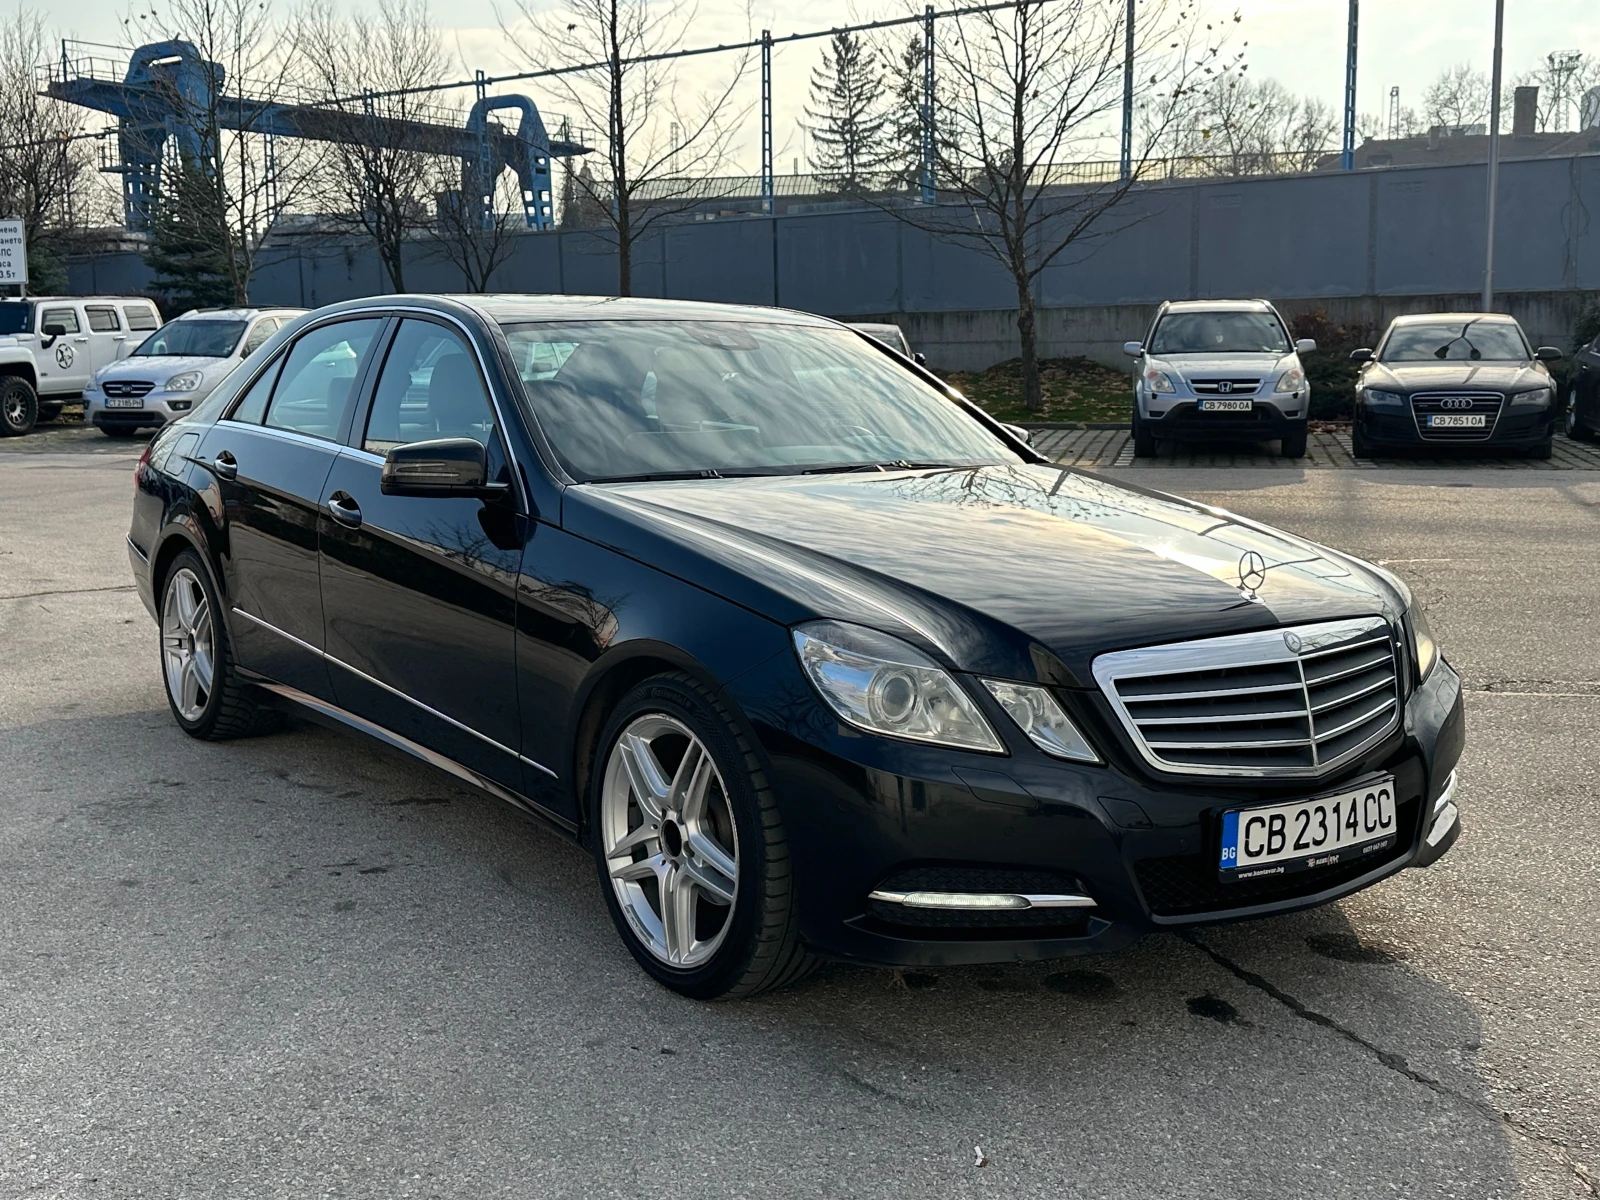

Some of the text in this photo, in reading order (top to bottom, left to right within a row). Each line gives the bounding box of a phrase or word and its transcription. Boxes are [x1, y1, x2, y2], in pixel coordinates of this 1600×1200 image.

[1433, 416, 1446, 425] CB
[1447, 416, 1469, 425] 7851
[1244, 788, 1392, 858] CB 2314 CC
[1221, 847, 1236, 861] BG
